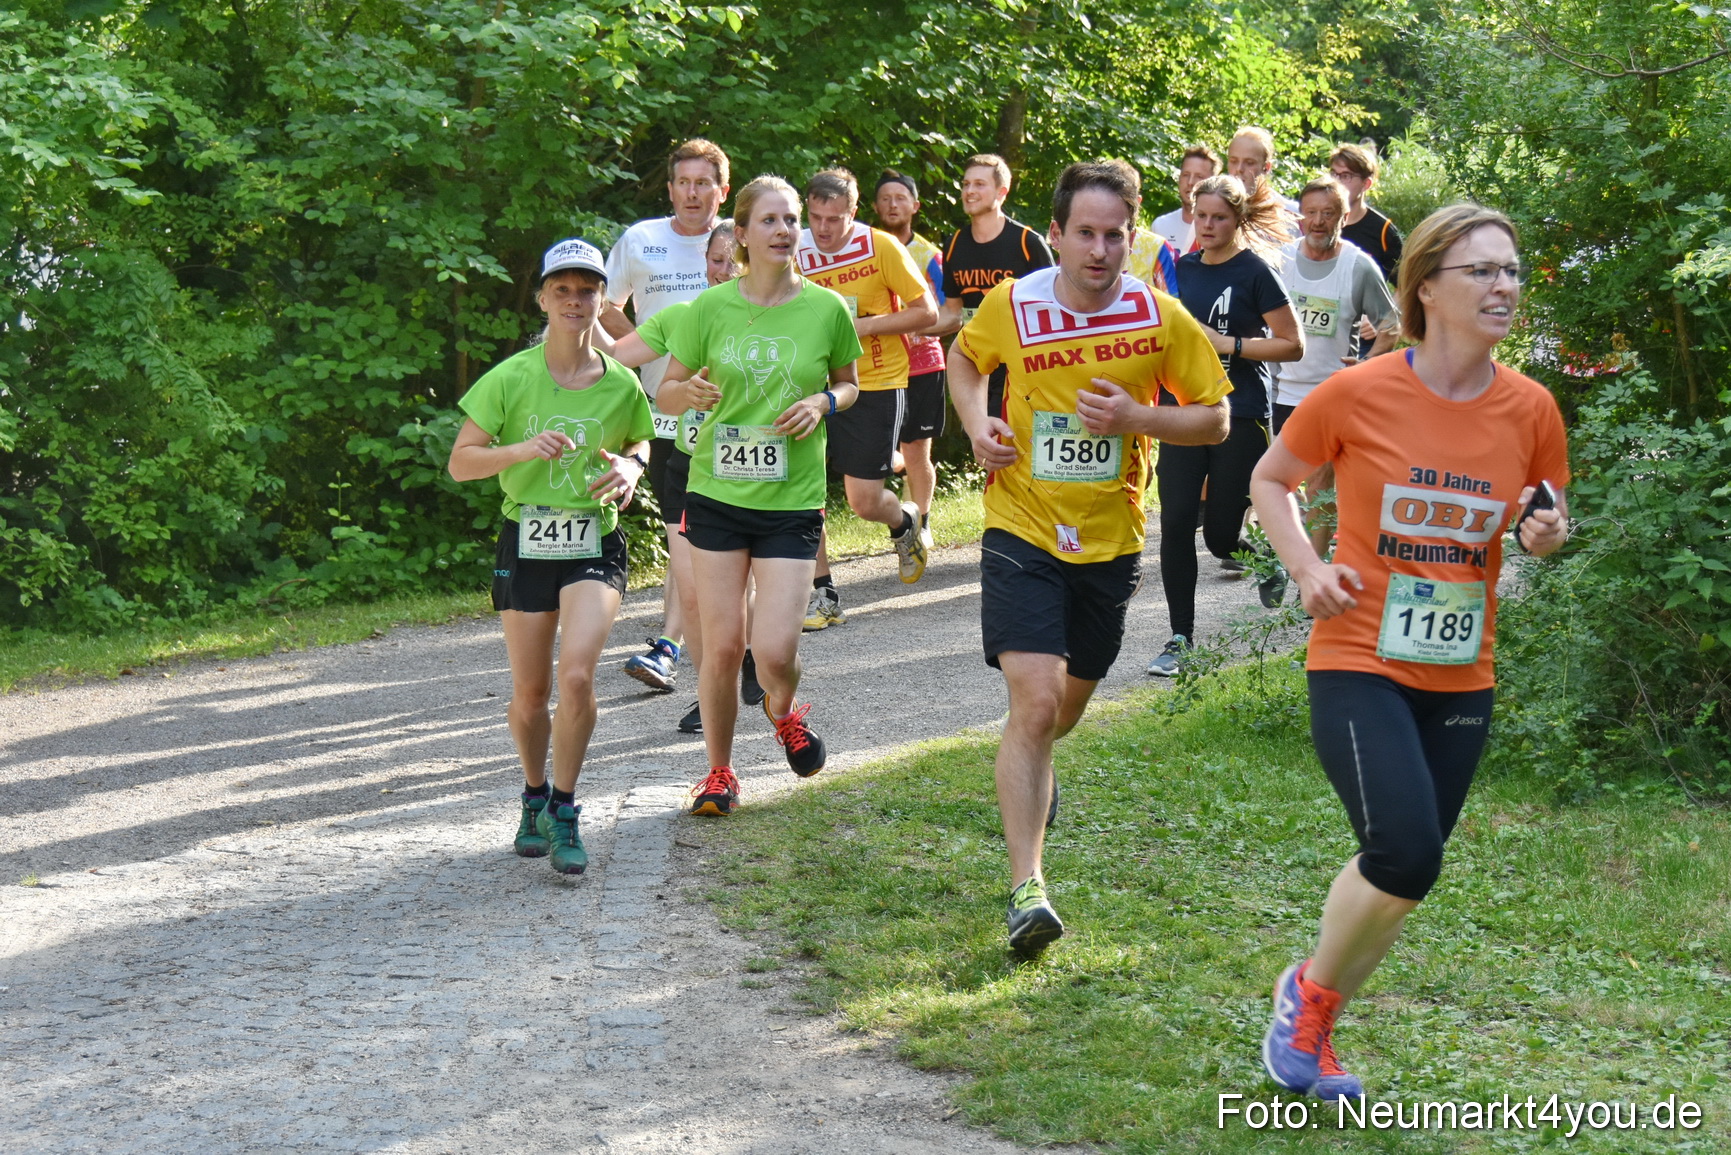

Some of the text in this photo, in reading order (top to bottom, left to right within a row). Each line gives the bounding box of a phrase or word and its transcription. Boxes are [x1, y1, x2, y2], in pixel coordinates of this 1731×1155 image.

[643, 246, 668, 254] DESS
[649, 273, 673, 282] Unser
[676, 272, 701, 281] Sport
[815, 264, 879, 288] AX BÖGL
[1296, 307, 1330, 327] 179
[1023, 337, 1164, 374] MAX BÖGL
[720, 444, 777, 466] 2418
[1043, 437, 1111, 464] 1580
[1055, 463, 1073, 471] Grad
[1408, 467, 1491, 495] 30 Jahre
[1391, 497, 1495, 533] OBI
[528, 519, 591, 542] 2417
[537, 542, 561, 550] Bergler
[1377, 533, 1488, 568] Neumarkt
[1398, 607, 1474, 642] 1189
[1412, 640, 1444, 650] Thomas
[1458, 716, 1484, 725] asics
